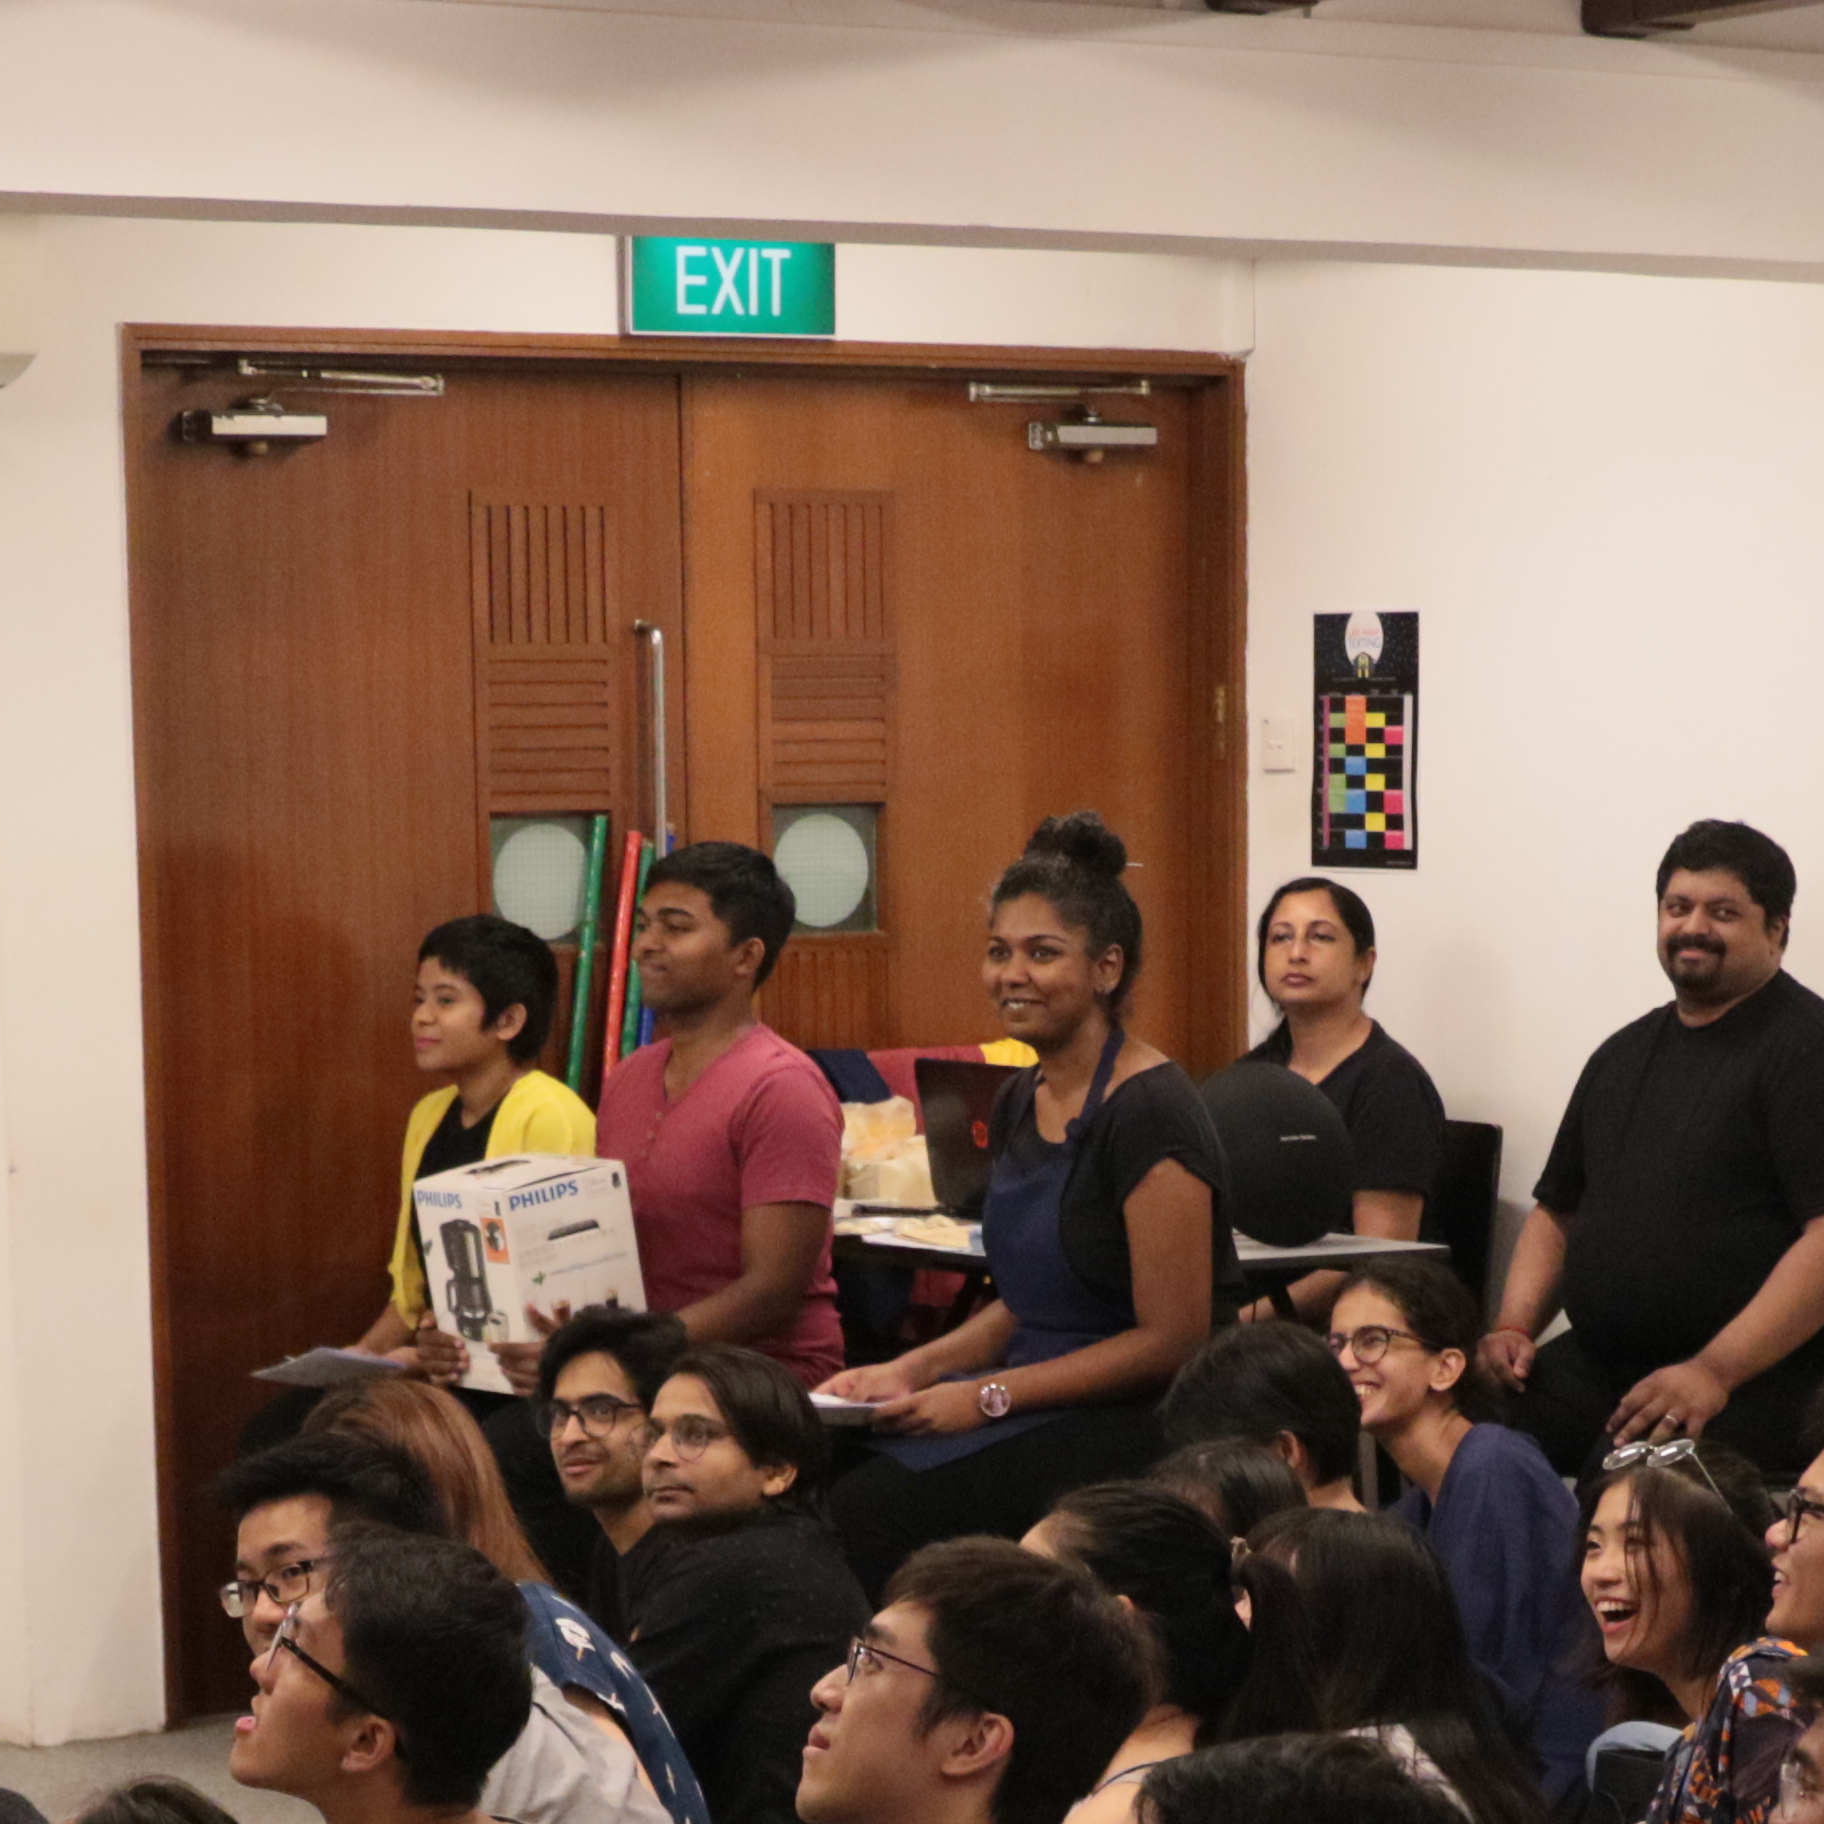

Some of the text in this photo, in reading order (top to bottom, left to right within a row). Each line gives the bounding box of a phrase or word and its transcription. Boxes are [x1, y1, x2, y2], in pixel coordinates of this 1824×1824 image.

[676, 246, 791, 316] EXIT
[416, 1190, 462, 1209] PHILIPS
[509, 1180, 578, 1211] PHILIPS
